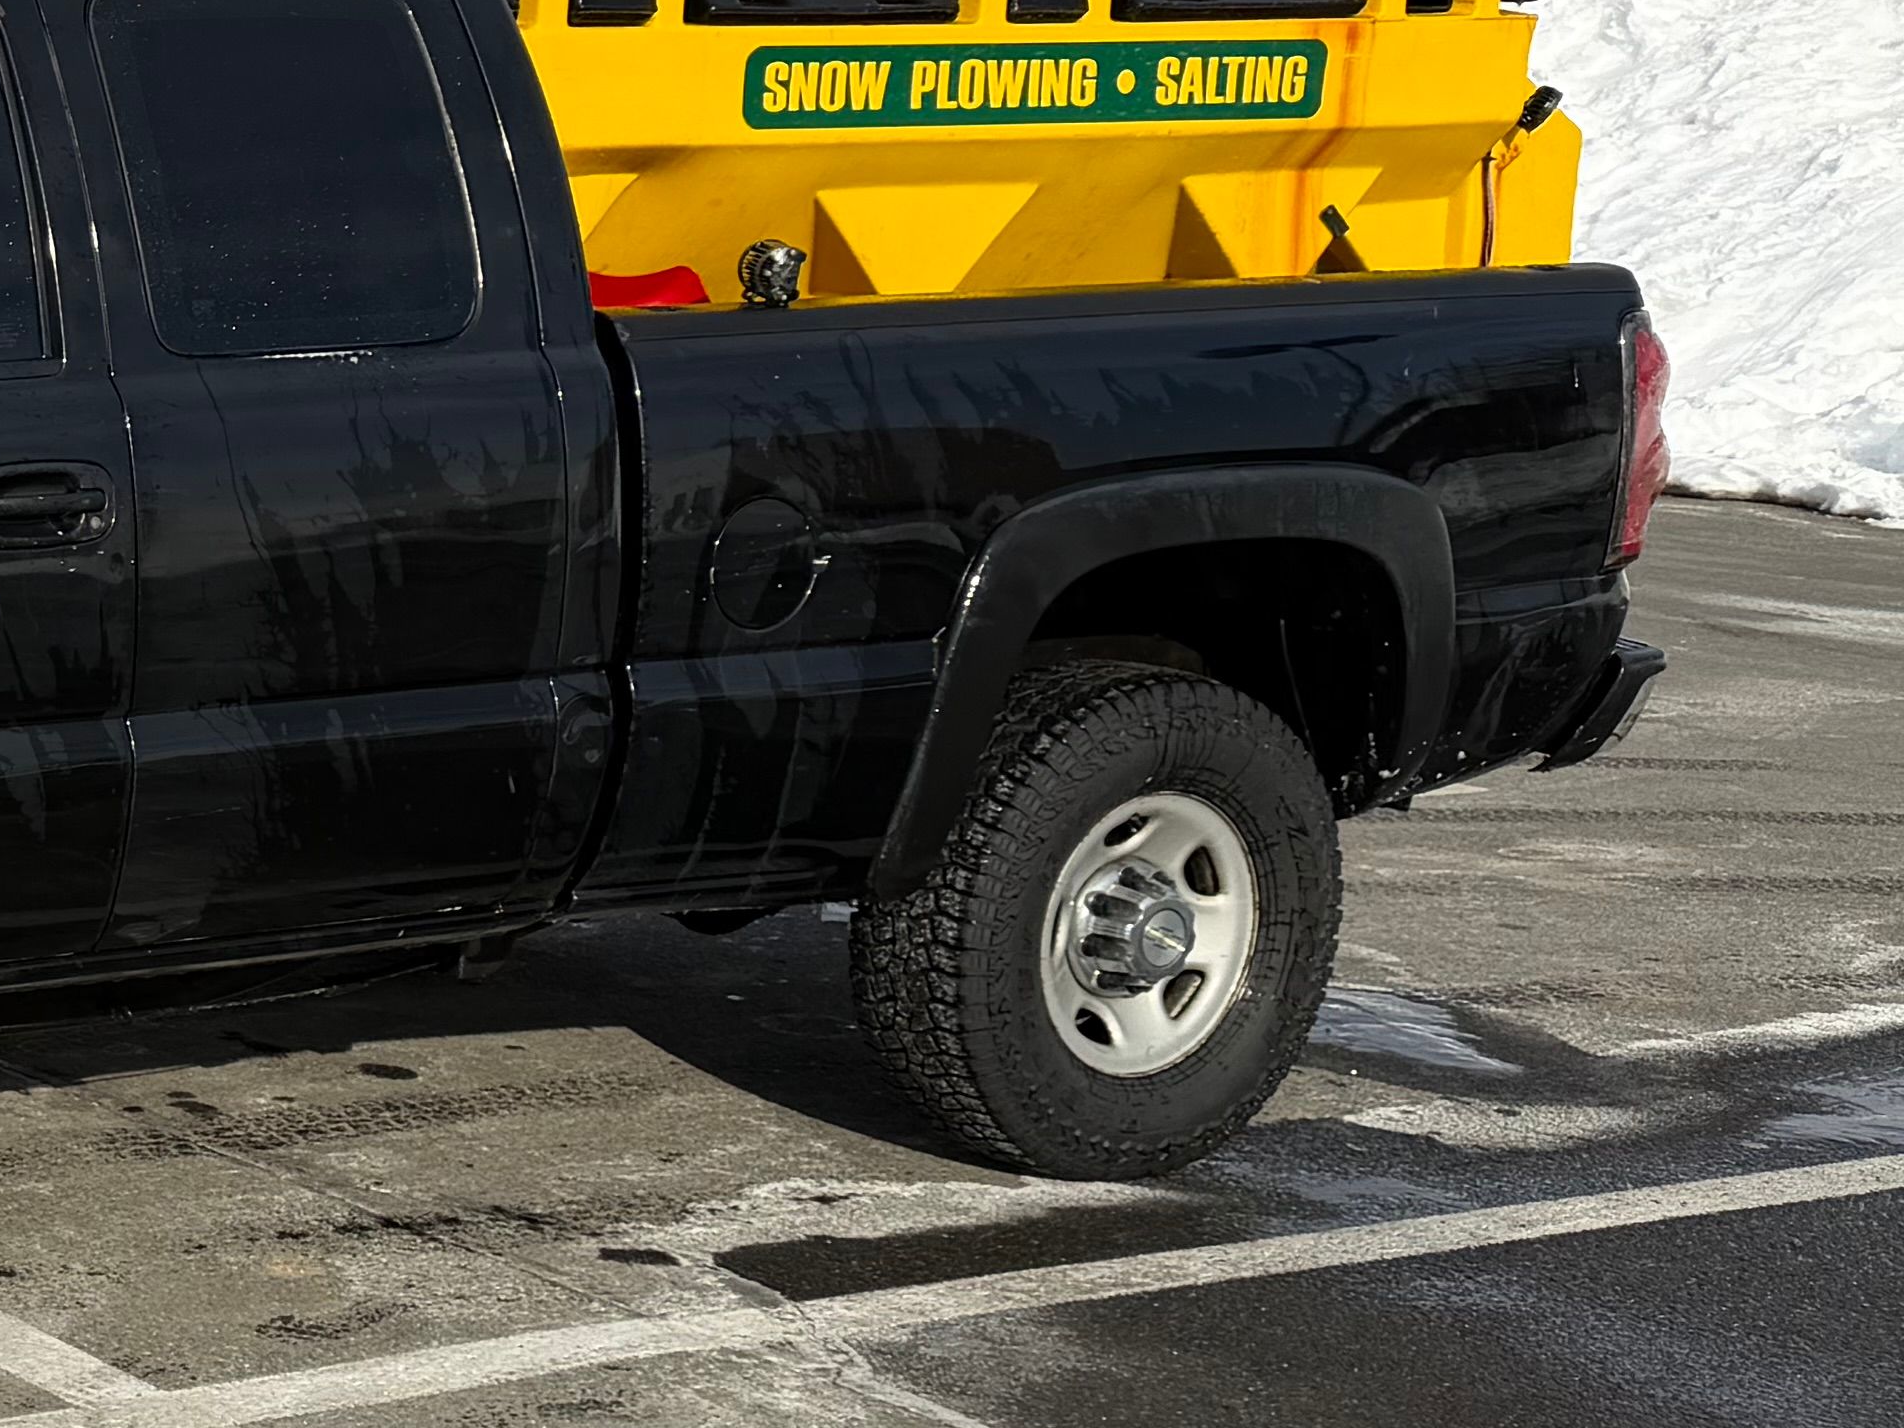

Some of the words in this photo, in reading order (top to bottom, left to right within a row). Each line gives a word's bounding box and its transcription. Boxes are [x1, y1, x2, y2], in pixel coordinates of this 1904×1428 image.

[762, 60, 892, 113] SNOW
[909, 58, 1097, 111] PLOWING
[1155, 55, 1308, 106] SALTING
